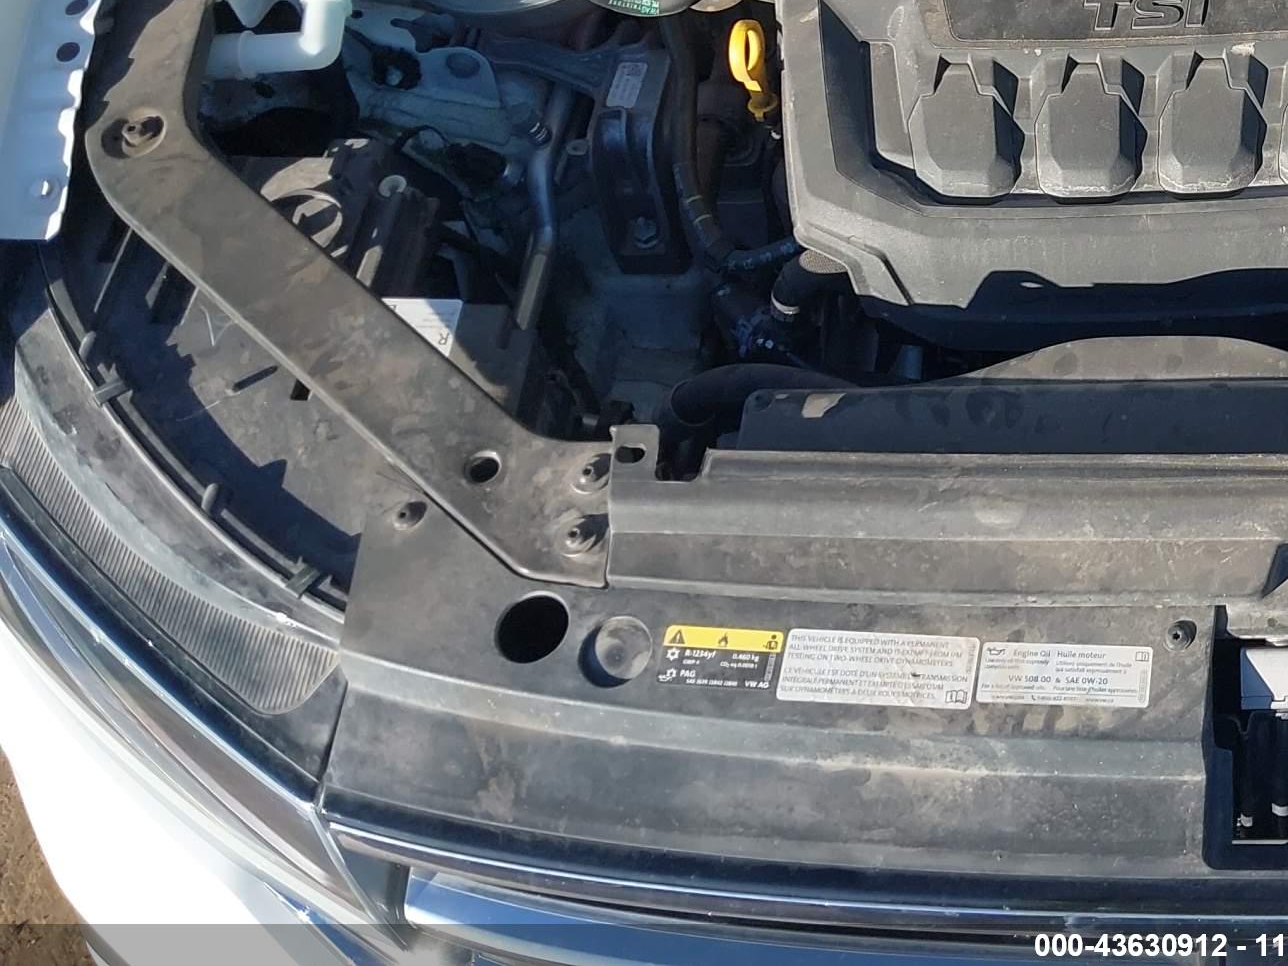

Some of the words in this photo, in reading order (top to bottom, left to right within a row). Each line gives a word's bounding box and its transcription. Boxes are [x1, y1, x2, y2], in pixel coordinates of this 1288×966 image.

[808, 635, 836, 643] VEHICLE
[845, 637, 880, 645] EQUIPPED
[684, 649, 716, 659] R-1234yf
[1014, 650, 1039, 658] Engine
[1057, 650, 1076, 658] Huile
[680, 669, 696, 677] PAG
